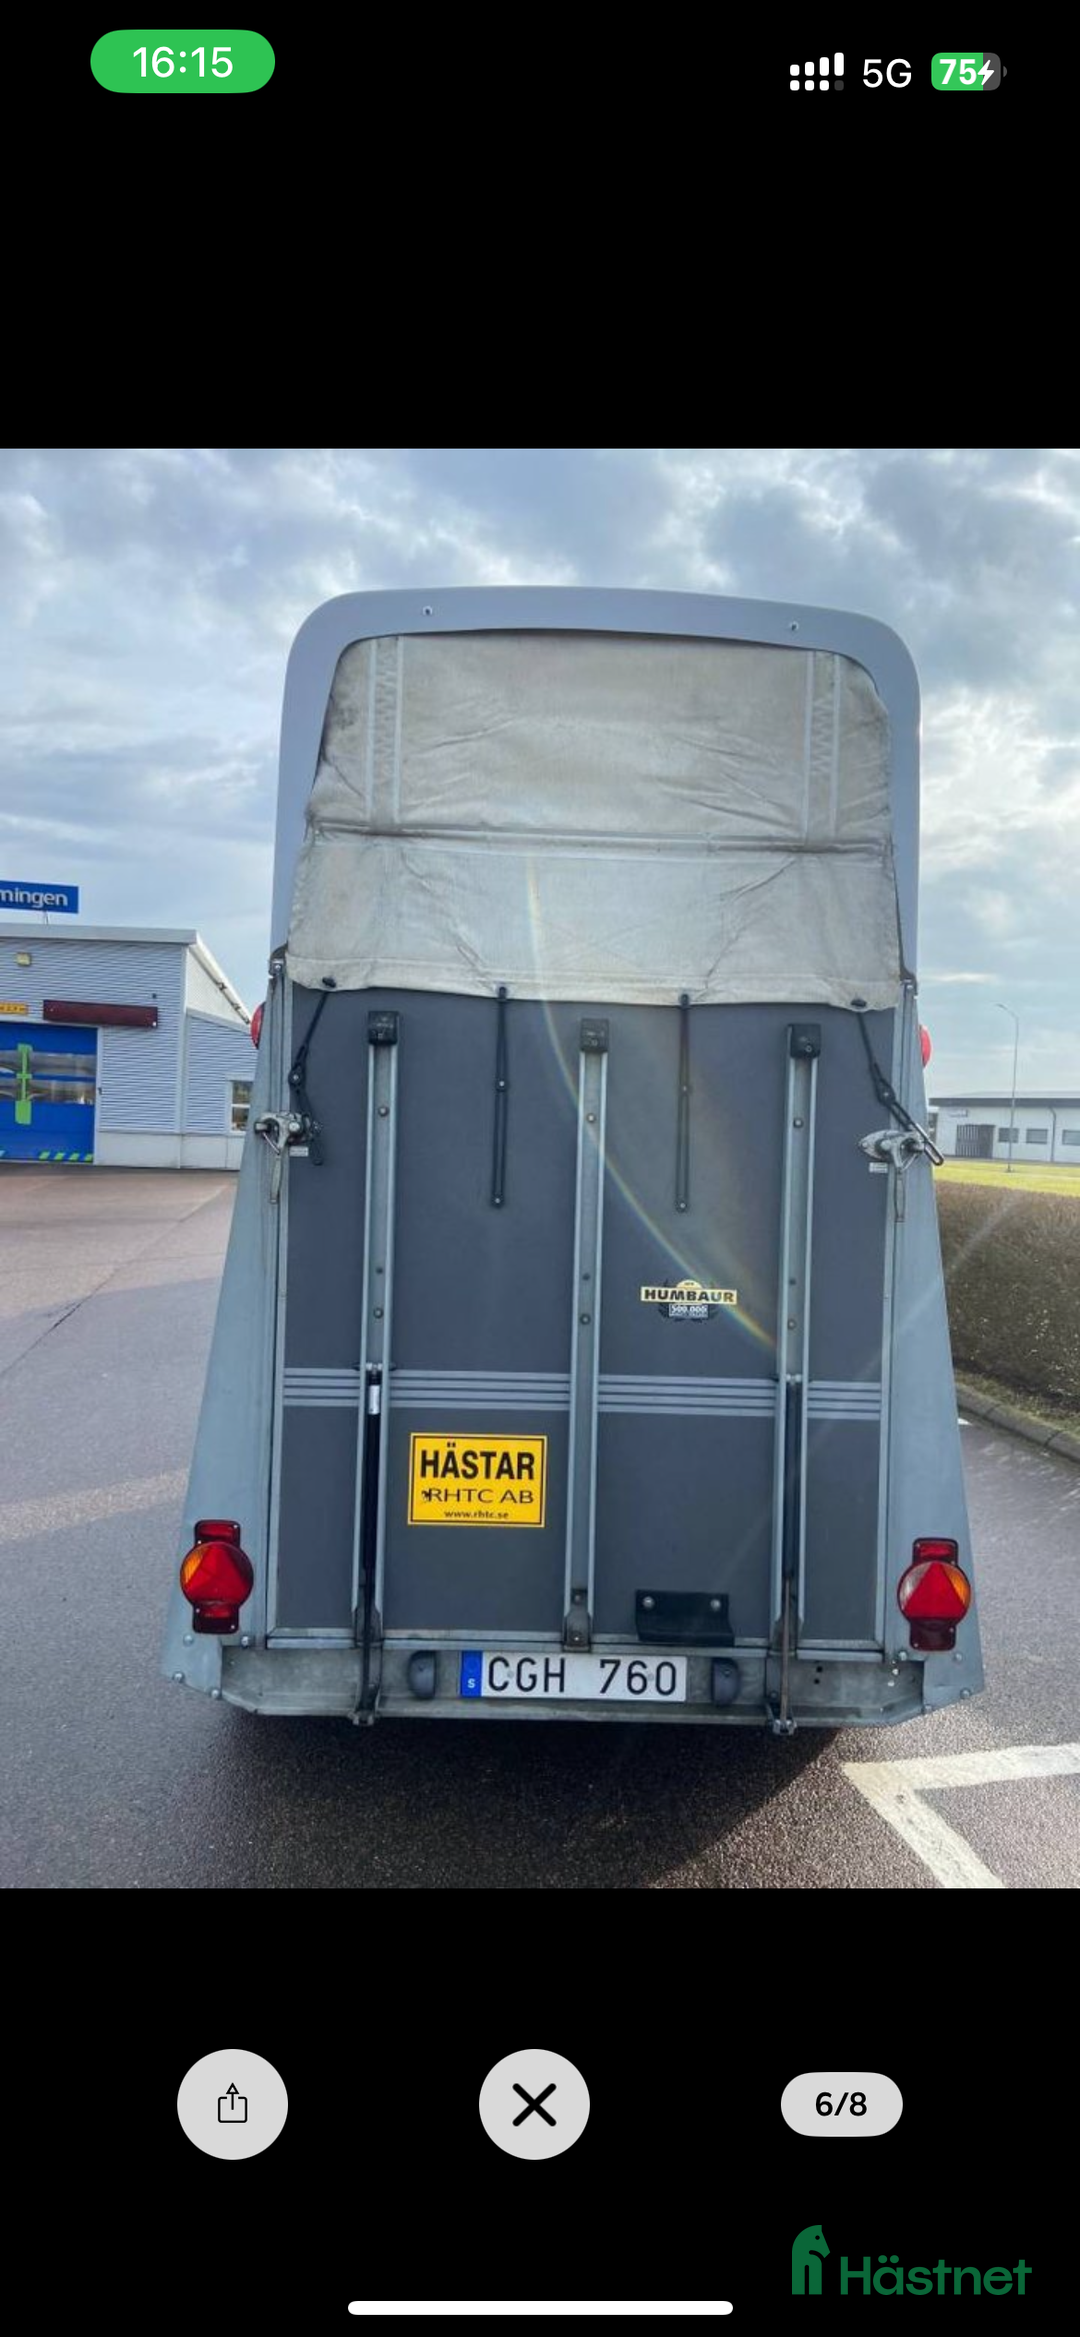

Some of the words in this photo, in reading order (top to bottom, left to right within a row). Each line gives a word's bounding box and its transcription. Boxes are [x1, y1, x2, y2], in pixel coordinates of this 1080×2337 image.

[644, 1289, 735, 1303] HUMBAUR
[420, 1441, 535, 1480] HÄSTAR
[428, 1488, 494, 1504] RHTC
[500, 1489, 534, 1504] AB
[444, 1510, 509, 1520] www.rhtc.se
[467, 1677, 476, 1689] S
[488, 1656, 565, 1693] CGH
[600, 1658, 677, 1696] 760
